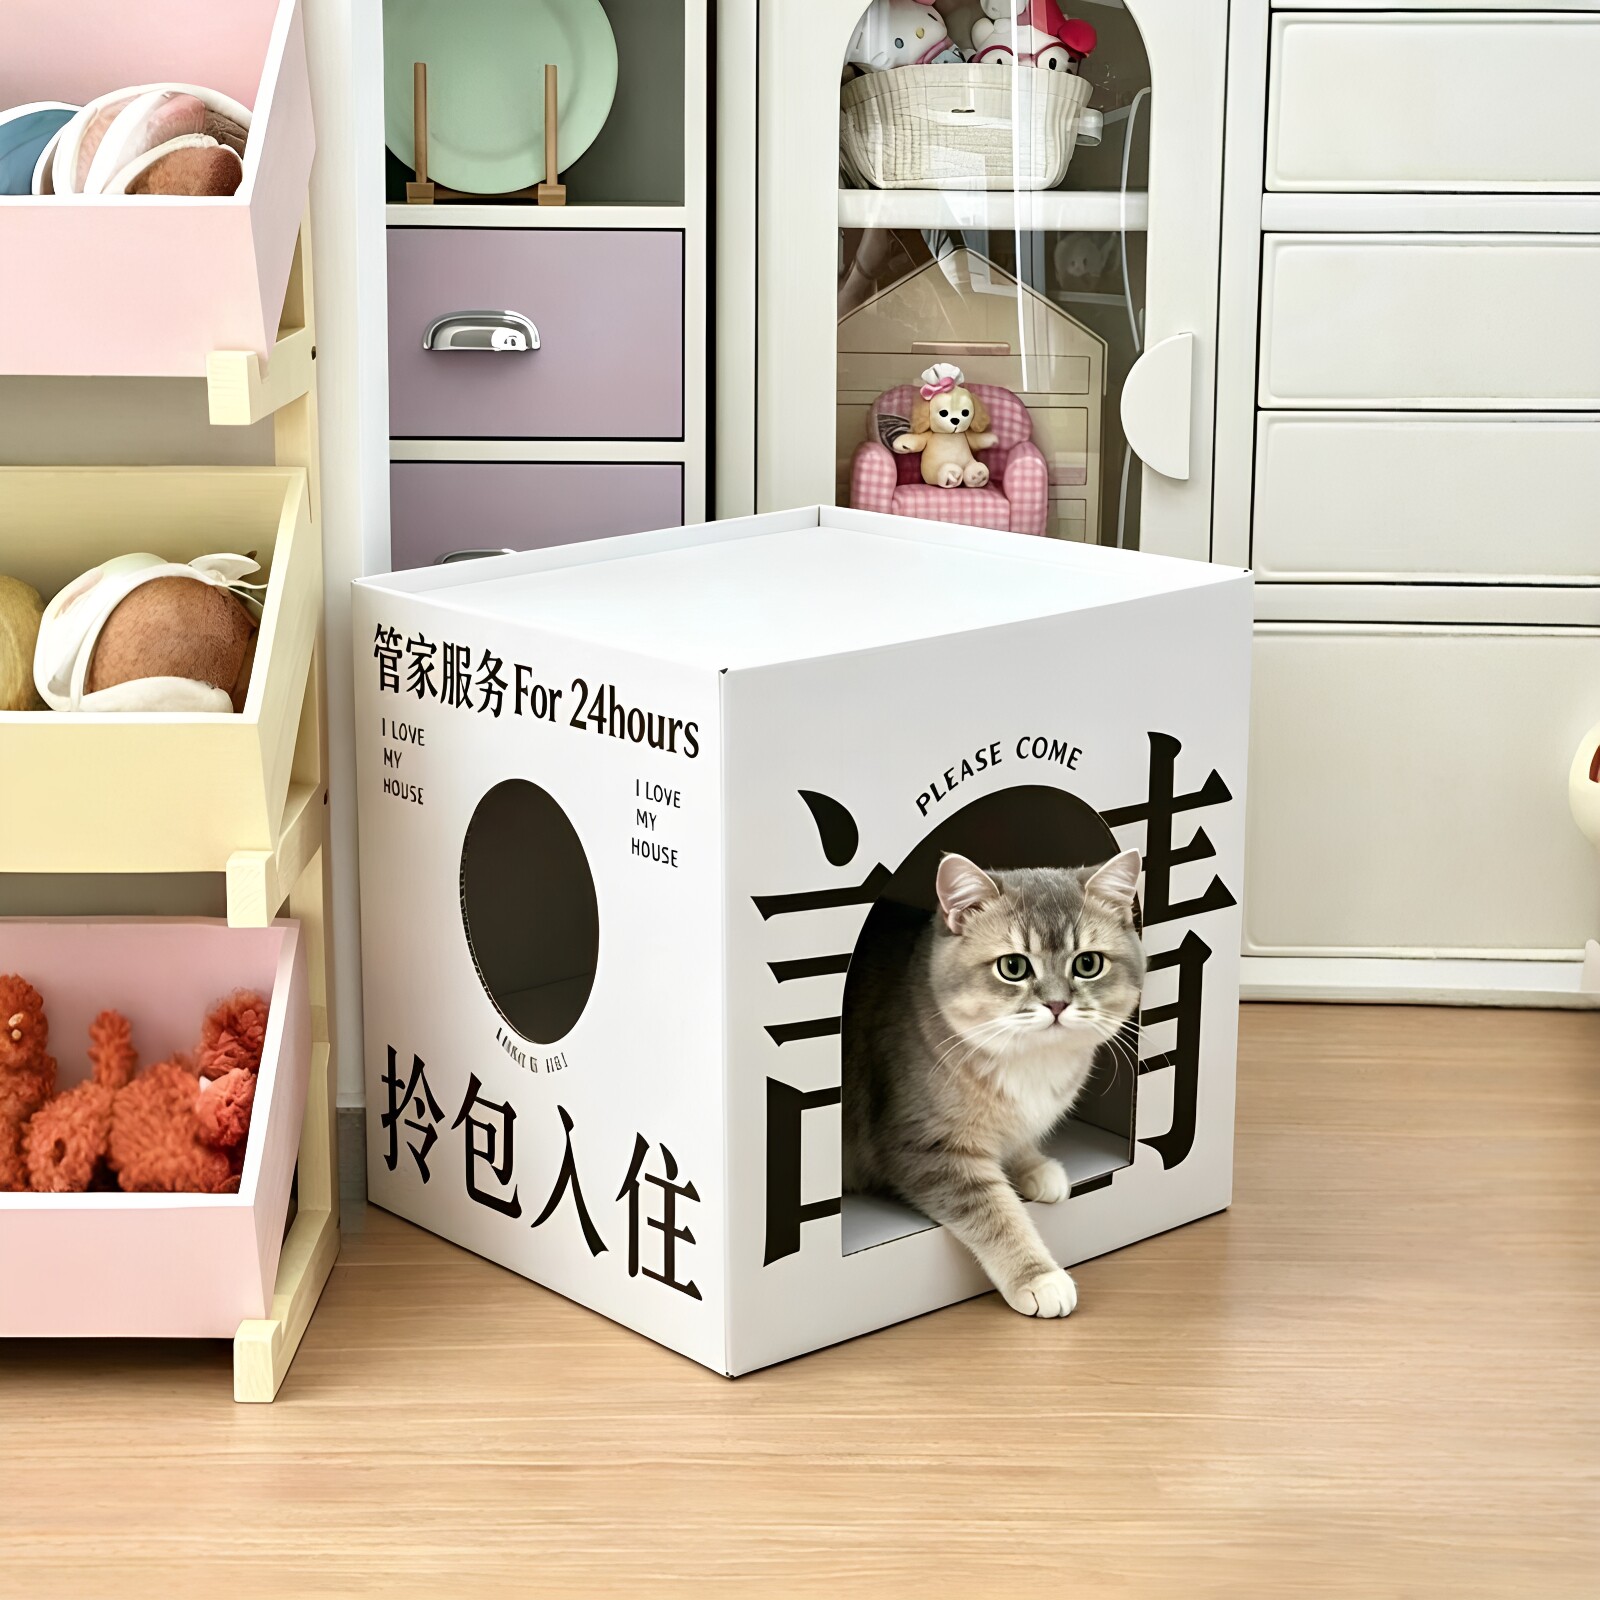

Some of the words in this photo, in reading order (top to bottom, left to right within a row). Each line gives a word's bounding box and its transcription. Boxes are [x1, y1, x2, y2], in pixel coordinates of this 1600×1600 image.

[373, 622, 509, 719] 管家服务
[513, 663, 563, 723] For
[569, 677, 700, 759] 24hours
[391, 720, 425, 747] LOVE
[383, 747, 403, 769] MY
[383, 777, 424, 806] HOUSE
[915, 741, 1003, 818] PLEASE
[1015, 736, 1083, 771] COME
[645, 780, 681, 809] LOVE
[636, 808, 657, 831] MY
[631, 837, 678, 868] HOUSE
[381, 1043, 703, 1302] 拎包入住
